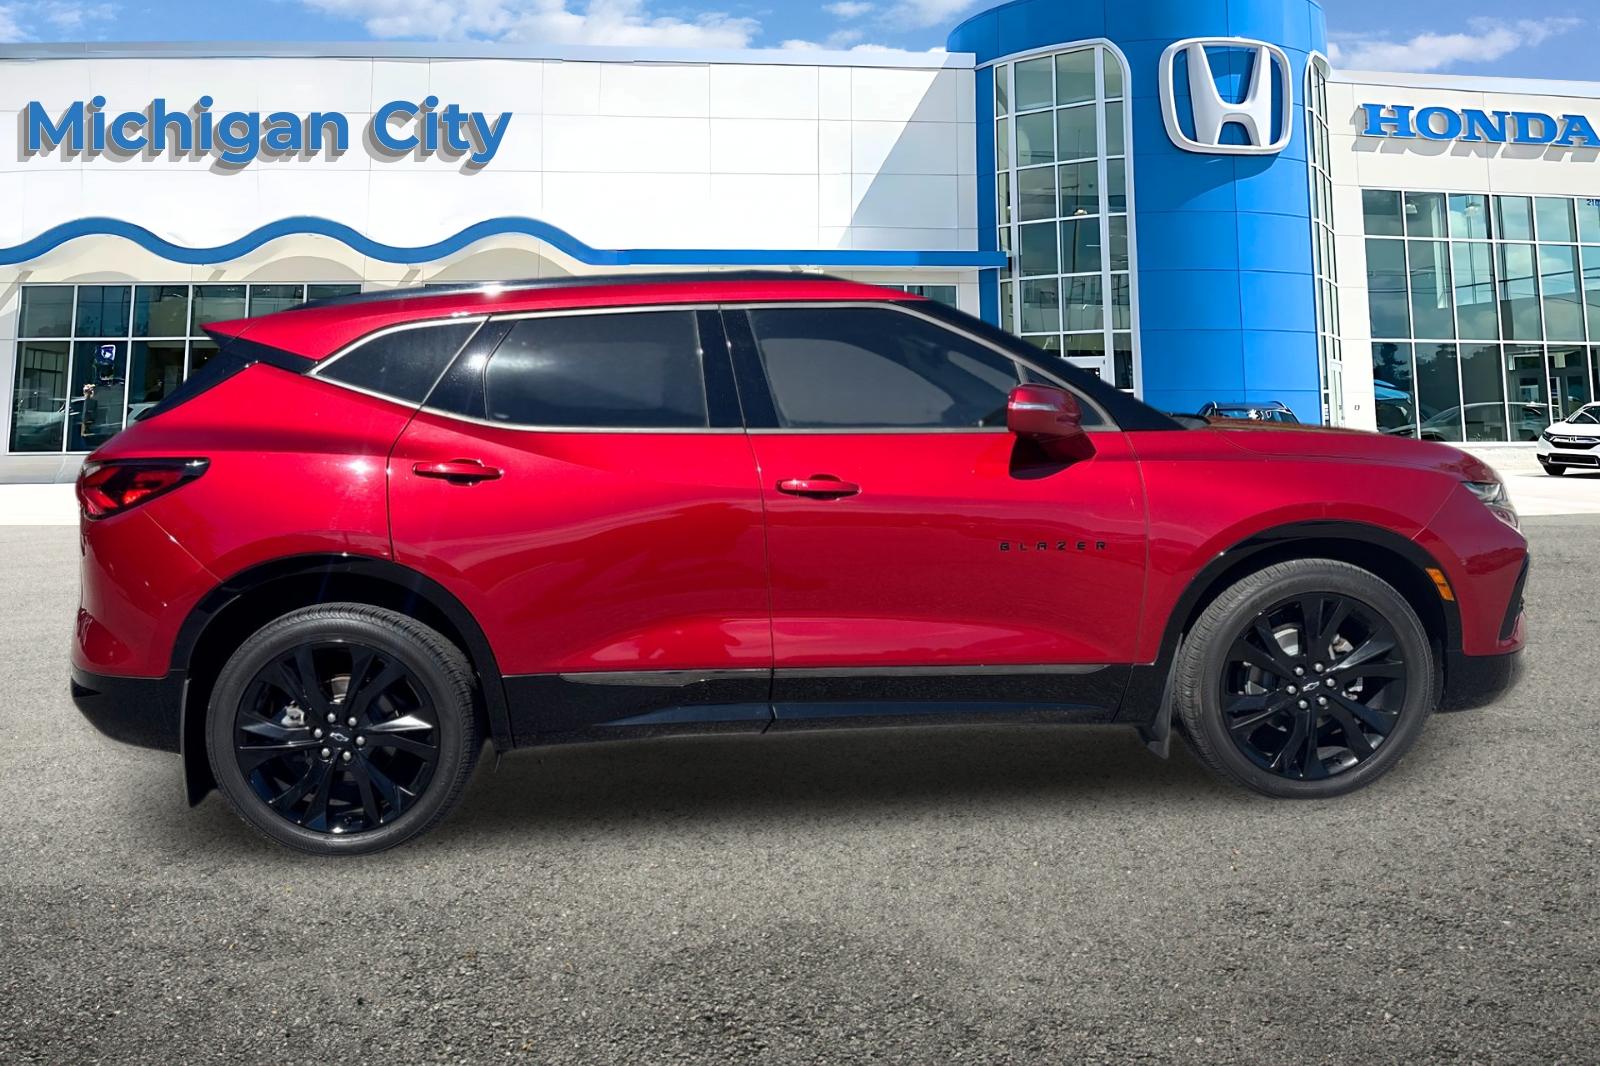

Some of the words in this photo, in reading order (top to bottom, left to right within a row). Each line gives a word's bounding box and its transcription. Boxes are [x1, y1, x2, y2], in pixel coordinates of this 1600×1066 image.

[28, 95, 349, 164] Michigan
[373, 95, 513, 164] City
[1362, 103, 1600, 147] HONDA
[999, 540, 1107, 551] BLAZER
